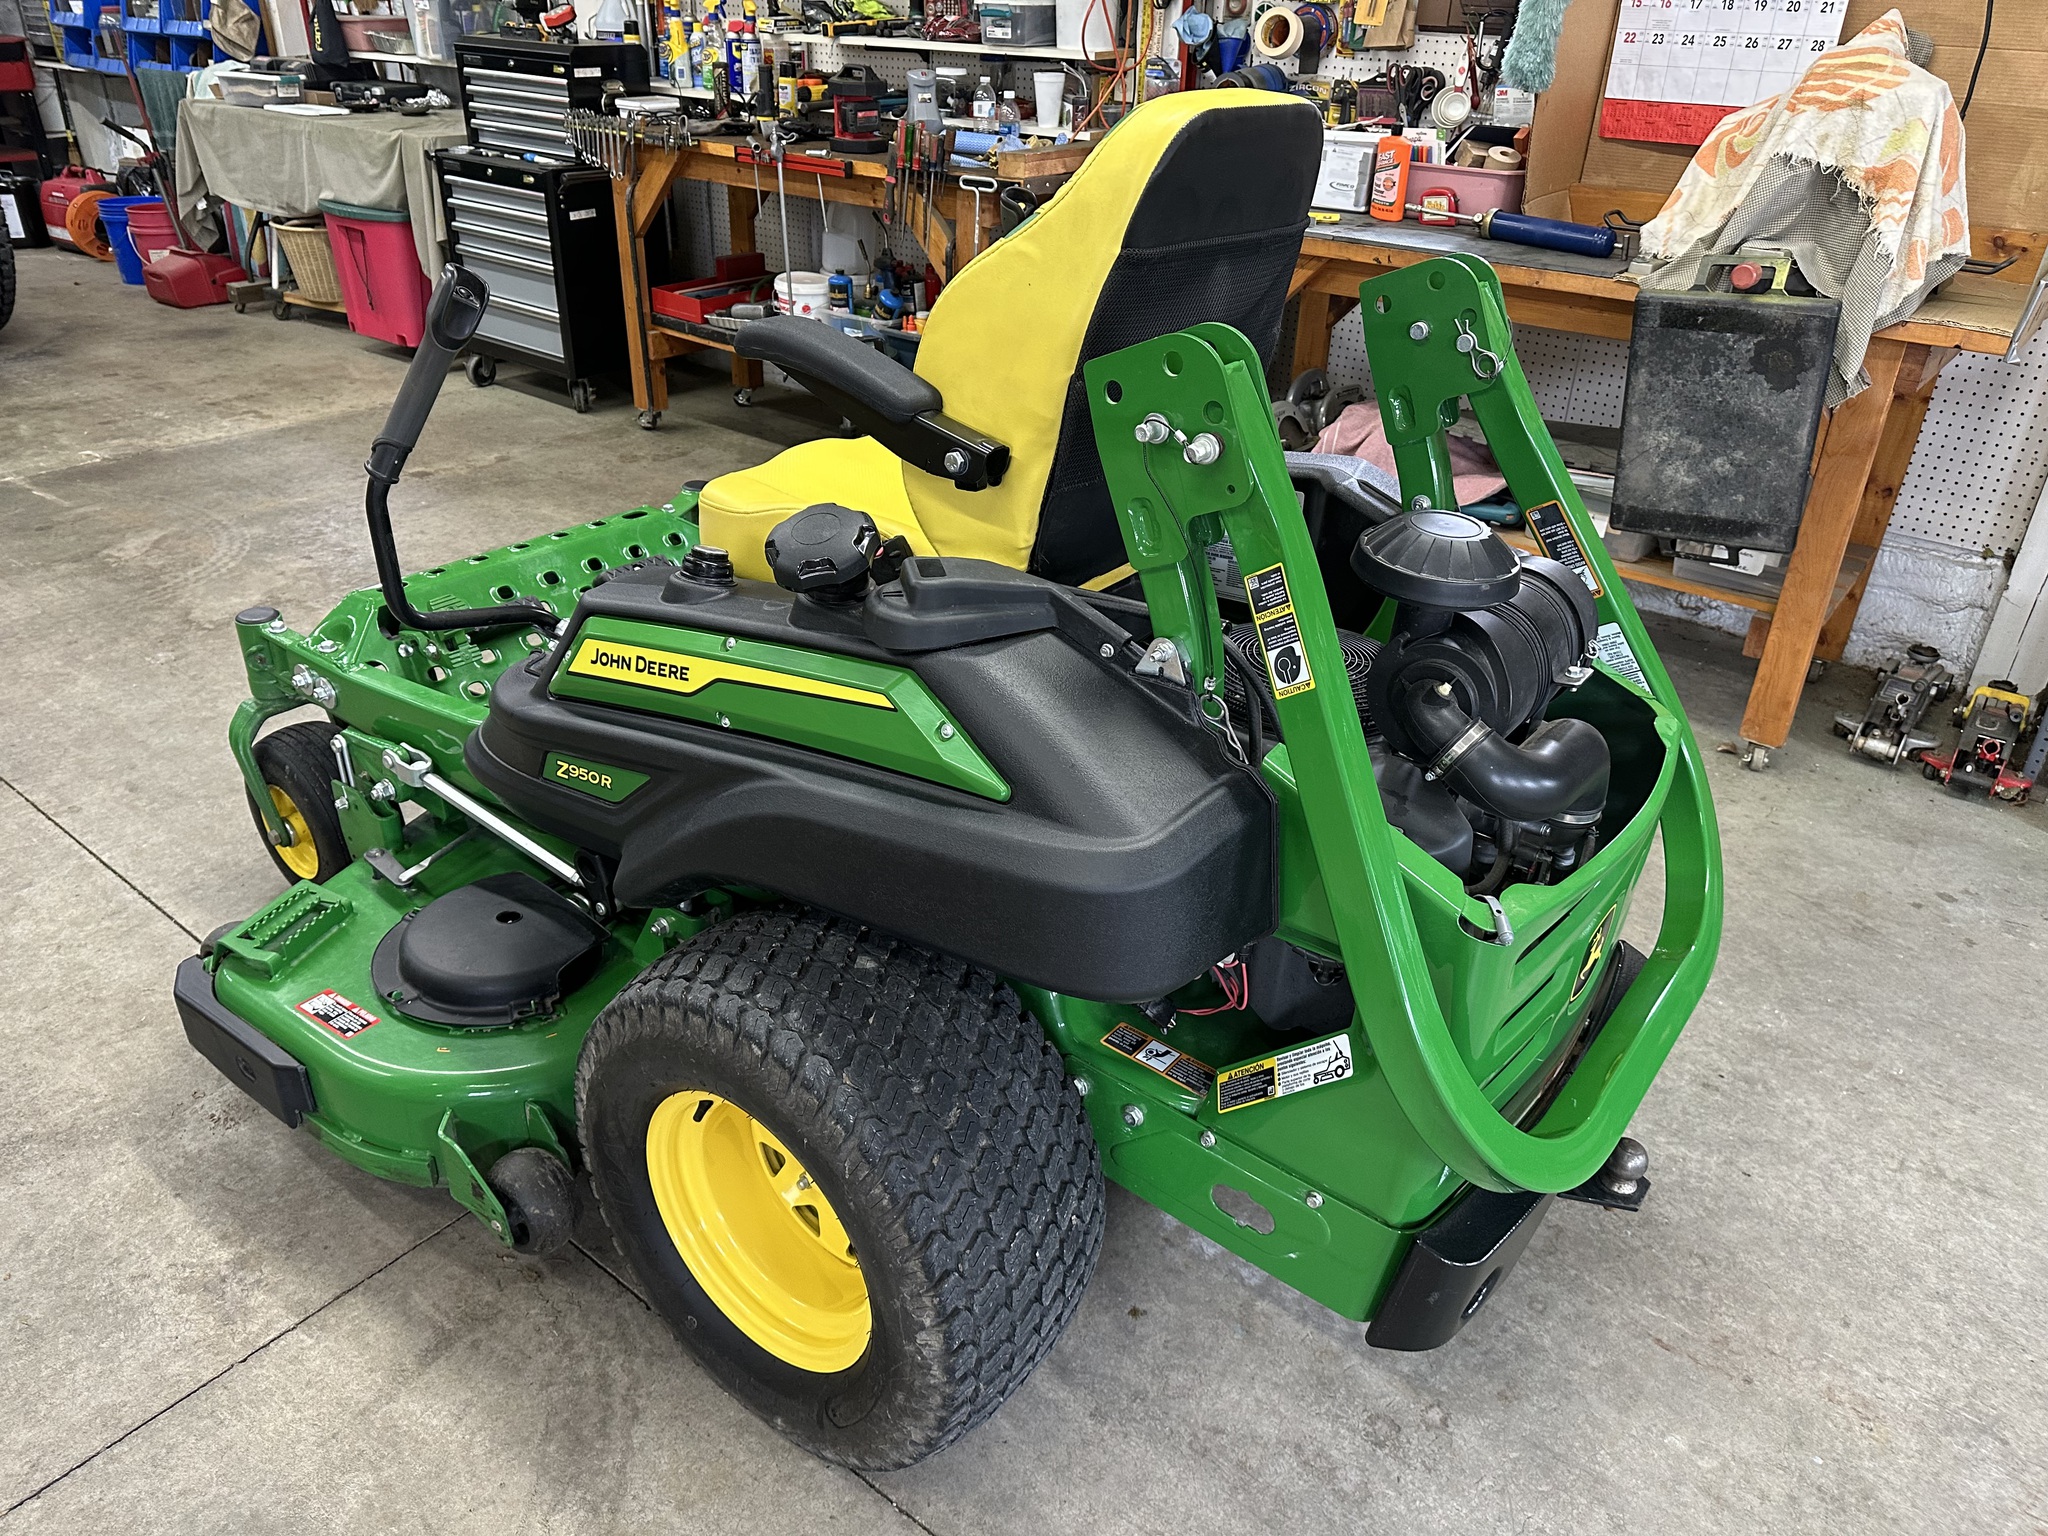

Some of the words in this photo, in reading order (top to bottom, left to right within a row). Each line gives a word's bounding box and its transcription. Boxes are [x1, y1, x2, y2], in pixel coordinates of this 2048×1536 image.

[1660, 0, 1671, 8] 16
[1690, 0, 1702, 9] 17
[1722, 0, 1734, 10] 18
[1755, 0, 1768, 11] 19
[1786, 0, 1801, 12] 20
[1820, 1, 1835, 13] 21
[1624, 32, 1637, 43] 22
[1651, 33, 1665, 44] 23
[1681, 34, 1695, 46] 24
[1713, 35, 1727, 47] 25
[1745, 37, 1759, 48] 26
[1777, 38, 1793, 50] 27
[1810, 40, 1825, 51] 28
[1289, 81, 1328, 95] ZIRCON
[1256, 607, 1286, 621] ATENCIÓN
[590, 648, 632, 671] JOHN
[635, 655, 690, 682] DEERE
[1278, 684, 1307, 697] CAUTION
[556, 760, 613, 789] Z950R
[1234, 1062, 1265, 1078] ATENCIÓN
